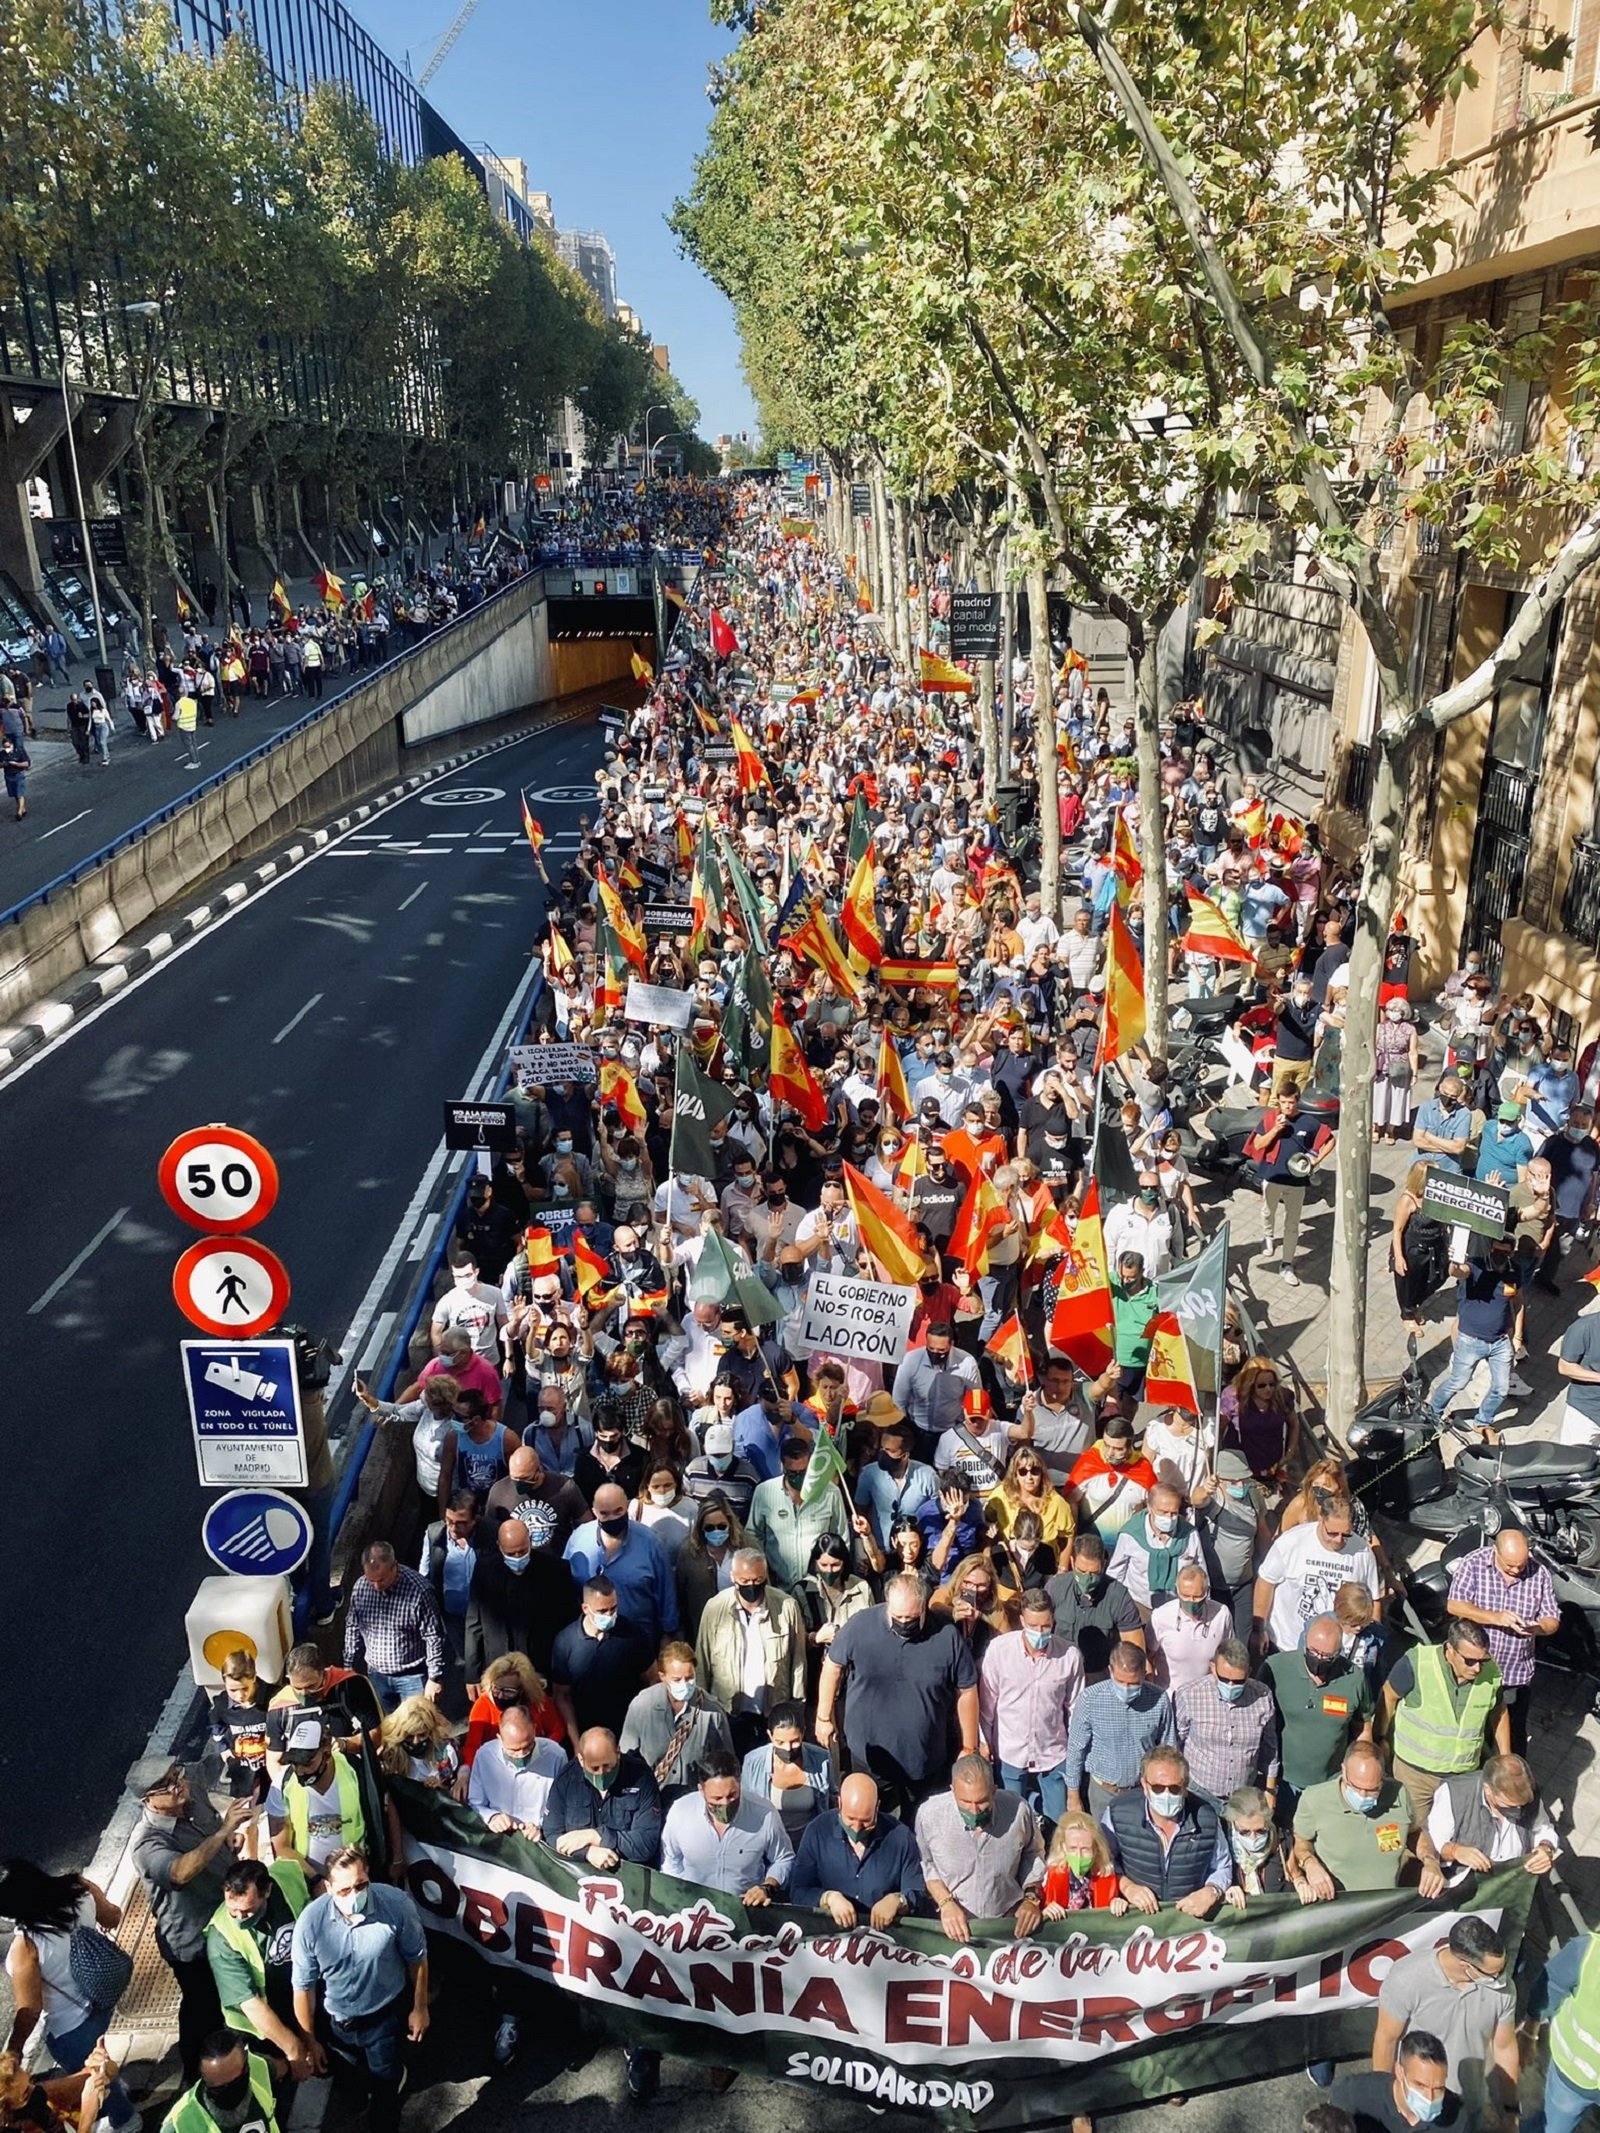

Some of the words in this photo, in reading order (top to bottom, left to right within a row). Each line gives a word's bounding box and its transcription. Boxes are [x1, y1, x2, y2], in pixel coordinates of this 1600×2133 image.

[953, 597, 991, 607] madrid
[953, 610, 986, 621] capital
[953, 622, 966, 632] de
[968, 622, 997, 632] moda
[441, 793, 485, 801] 50
[551, 790, 594, 798] 50
[528, 1046, 568, 1055] IZQUIERDA
[521, 1075, 542, 1086] SOLO
[188, 1163, 252, 1198] 50
[922, 1194, 955, 1204] adidas
[1427, 1178, 1505, 1210] SOBERANÍA
[1425, 1190, 1503, 1221] ENERGÉTICA
[815, 1279, 833, 1296] EL
[838, 1285, 908, 1307] GOBIERNO
[813, 1299, 849, 1316] NOS
[851, 1306, 897, 1326] ROBA
[804, 1321, 898, 1356] LADRÓN
[263, 1420, 294, 1430] TÚNEL
[216, 1444, 284, 1452] AYUNTAMIENTO
[245, 1454, 257, 1462] DE
[234, 1464, 271, 1473] MADRID
[1305, 1559, 1354, 1573] CERTIFICADO
[1319, 1570, 1343, 1579] COVID
[583, 1882, 732, 1954] Frente
[745, 1927, 798, 1957] al
[991, 1935, 1048, 1985] de
[1060, 1934, 1109, 1977] la
[407, 1859, 860, 2035] OBERANÍA
